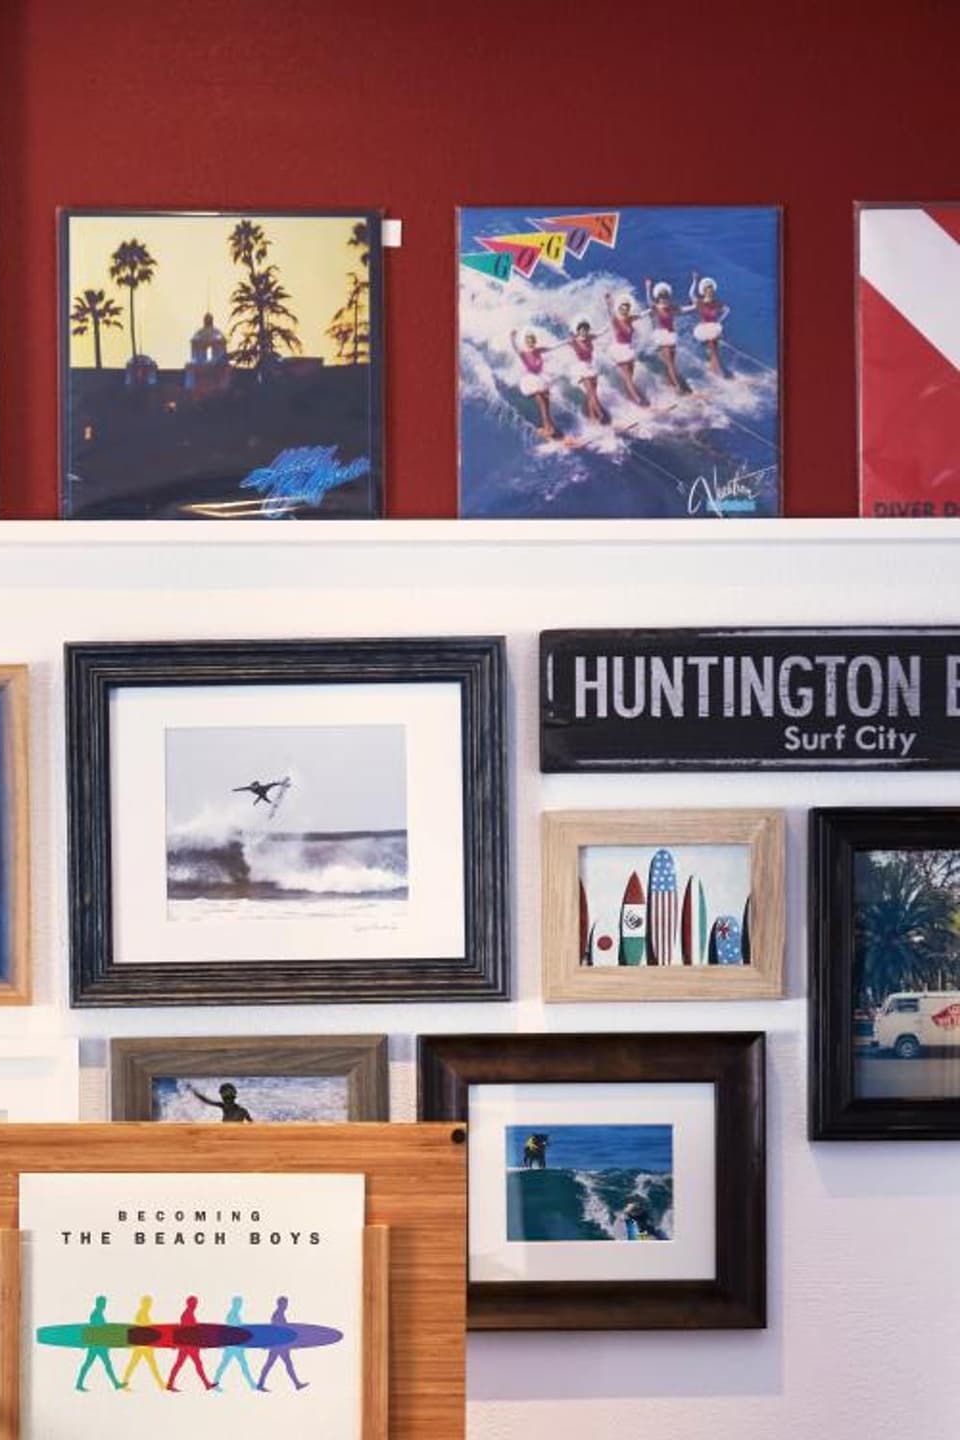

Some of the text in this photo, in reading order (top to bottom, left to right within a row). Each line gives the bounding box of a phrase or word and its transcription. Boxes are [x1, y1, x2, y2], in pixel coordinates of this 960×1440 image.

[575, 655, 921, 718] HUNTINGTON
[784, 725, 918, 756] Surf City
[118, 1210, 262, 1222] BECOMING
[61, 1231, 321, 1245] THE BEACH BOYS
